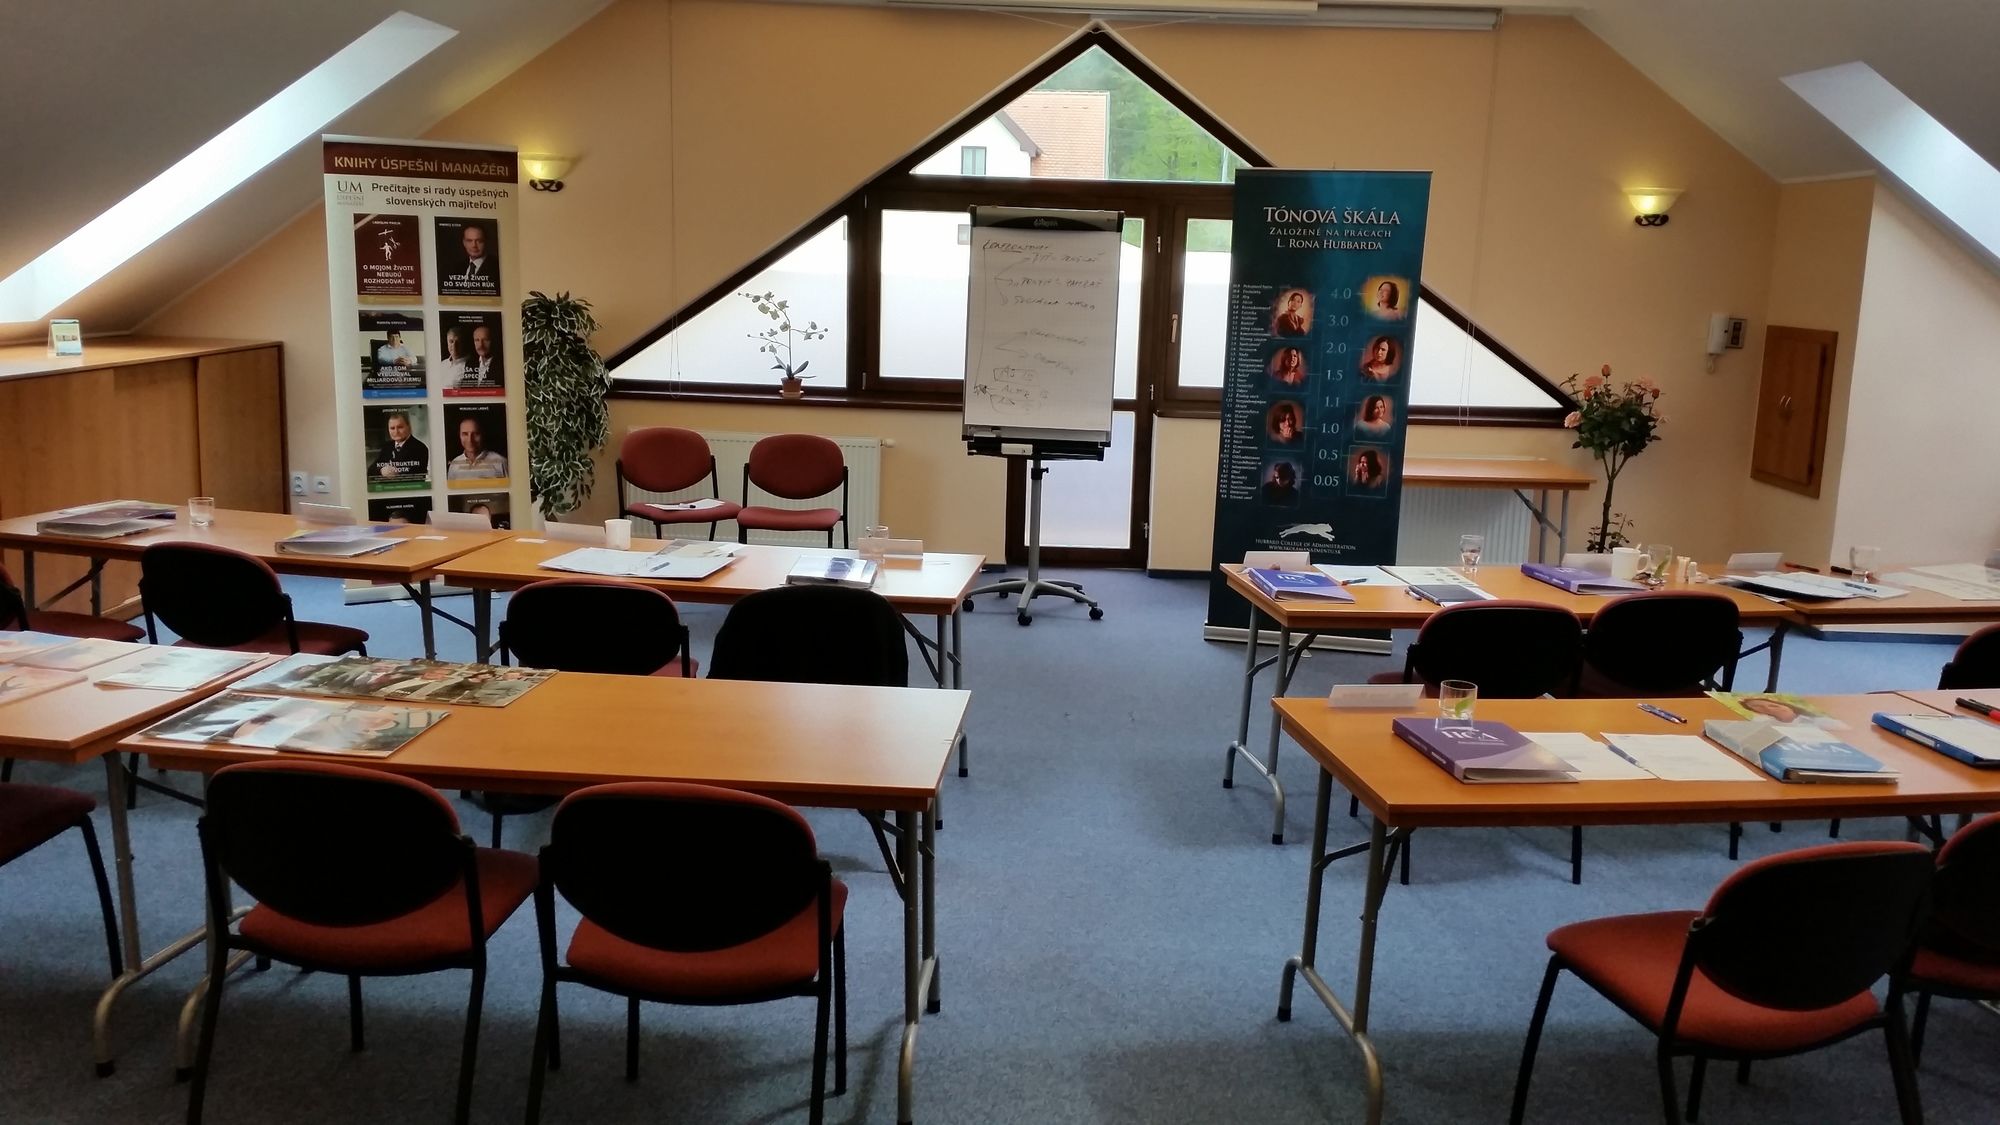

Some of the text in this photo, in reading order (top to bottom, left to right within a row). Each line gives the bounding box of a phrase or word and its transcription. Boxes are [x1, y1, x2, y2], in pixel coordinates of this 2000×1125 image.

[334, 156, 509, 177] KNIHY ÚSPEŠNÍ MANAŽÉRI
[337, 180, 363, 193] UM
[371, 183, 509, 200] Prečítajte si rady úspešných
[386, 196, 446, 208] slovenských
[1263, 205, 1401, 226] TÓNOVÁ ŠKÁLA
[1269, 226, 1321, 237] ZALOŽENÉ
[1277, 239, 1383, 251] L. RONA HUBBARDA
[370, 264, 392, 272] MOJOM
[394, 263, 414, 272] ŽIVOTE
[470, 273, 490, 282] ŽIVOT
[1330, 288, 1351, 300] 4.0
[1329, 315, 1349, 327] 3.0
[1326, 343, 1347, 354] 2.0
[1327, 370, 1343, 381] 1.5
[1325, 396, 1339, 408] 1.1
[1321, 423, 1340, 434] 1.0
[1319, 449, 1338, 460] 0.5
[1314, 475, 1339, 487] 0.05
